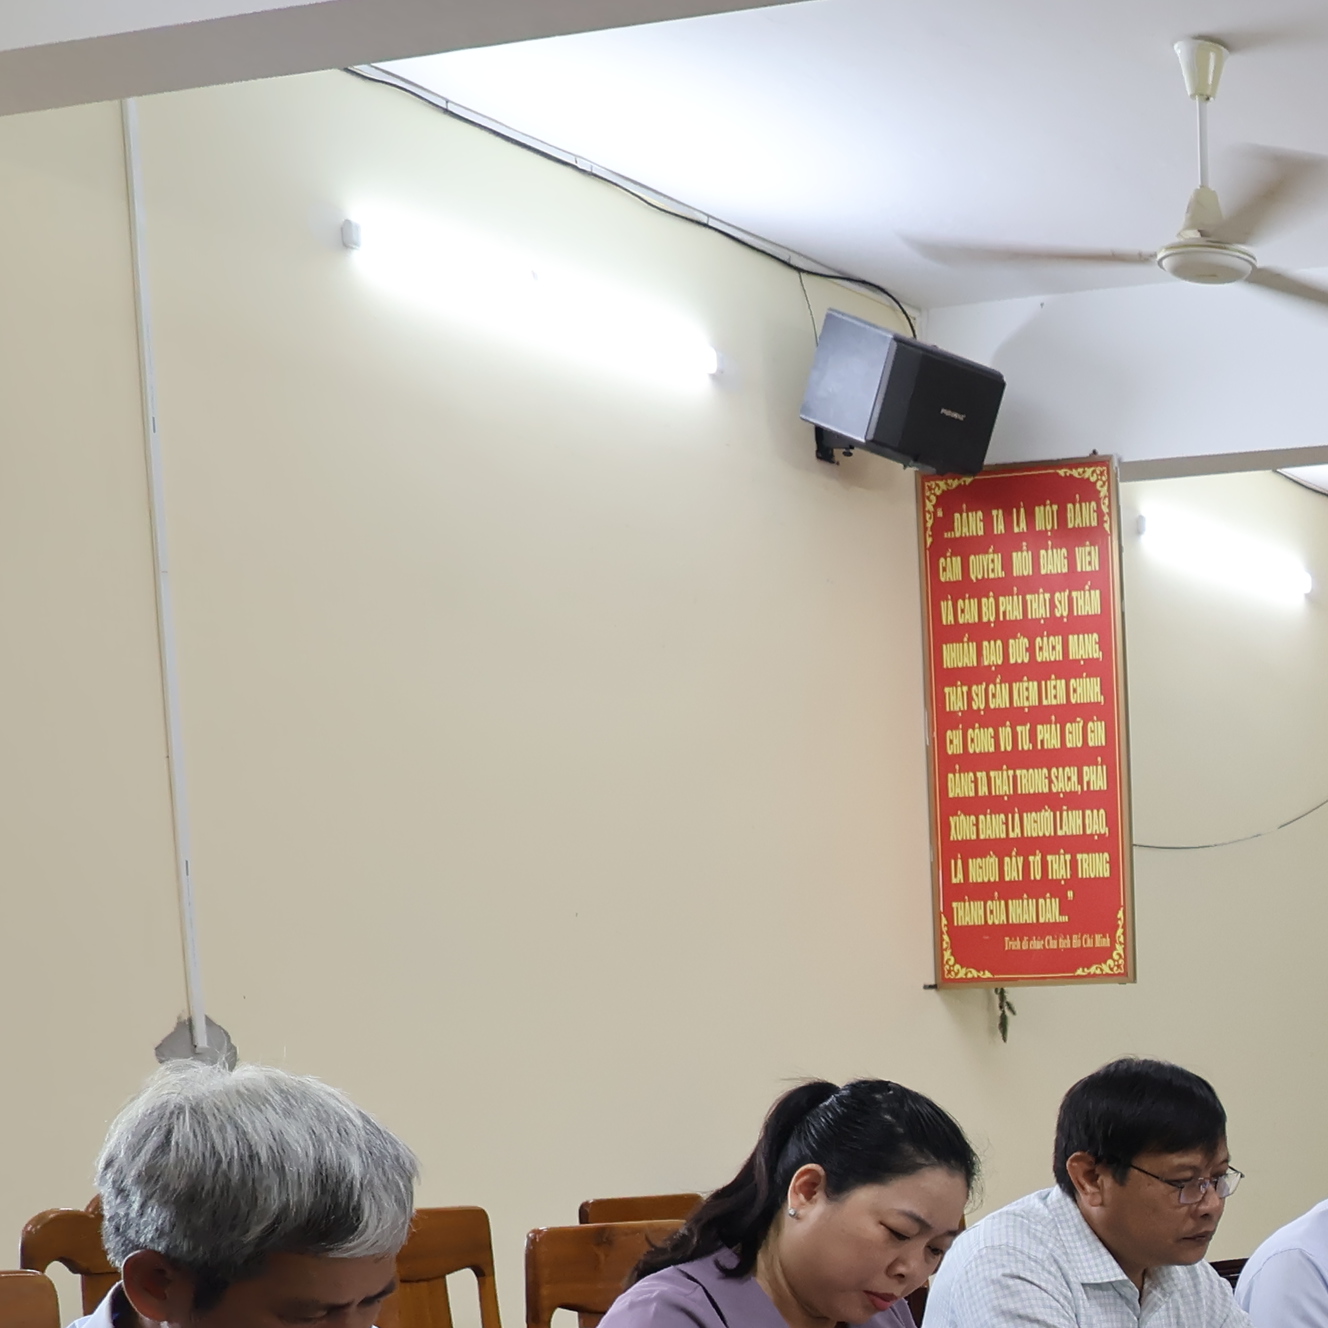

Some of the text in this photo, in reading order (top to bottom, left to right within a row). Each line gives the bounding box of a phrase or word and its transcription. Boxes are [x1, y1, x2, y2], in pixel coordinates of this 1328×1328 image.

[991, 508, 1004, 534] TA
[1012, 501, 1026, 533] LÀ
[1034, 499, 1058, 535] MỘT
[1066, 493, 1097, 528] ĐẢNG
[940, 594, 954, 625] VÀ
[957, 593, 978, 624] CÁN
[981, 591, 995, 627] BỘ
[998, 586, 1022, 621] PHẢI
[1025, 588, 1050, 623] THẬT
[1054, 588, 1069, 622] SỰ
[943, 680, 968, 716] THẬT
[971, 681, 985, 715] SỰ
[1012, 675, 1038, 712] KIỆM
[1041, 674, 1066, 705] LIÊM
[1069, 672, 1104, 705] CHÍNH,
[945, 715, 1105, 754] CHÍ CÔNG VÔ TƯ. PHẢI GIỮ GÌN
[947, 756, 1107, 800] ĐẢNG TA THẬT TRONG SẠCH, PHẢI
[978, 808, 1006, 839] ĐÁNG
[1007, 807, 1021, 838] LÀ
[1055, 805, 1083, 835] LÃNH
[1084, 808, 1108, 839] ĐẠO,
[950, 853, 963, 883] LÀ
[1046, 848, 1071, 884] THẬT
[1076, 851, 1110, 878] TRUNG
[951, 895, 984, 926] THÀNH
[986, 891, 1006, 925] CỦA
[1007, 893, 1036, 923] NHÂN
